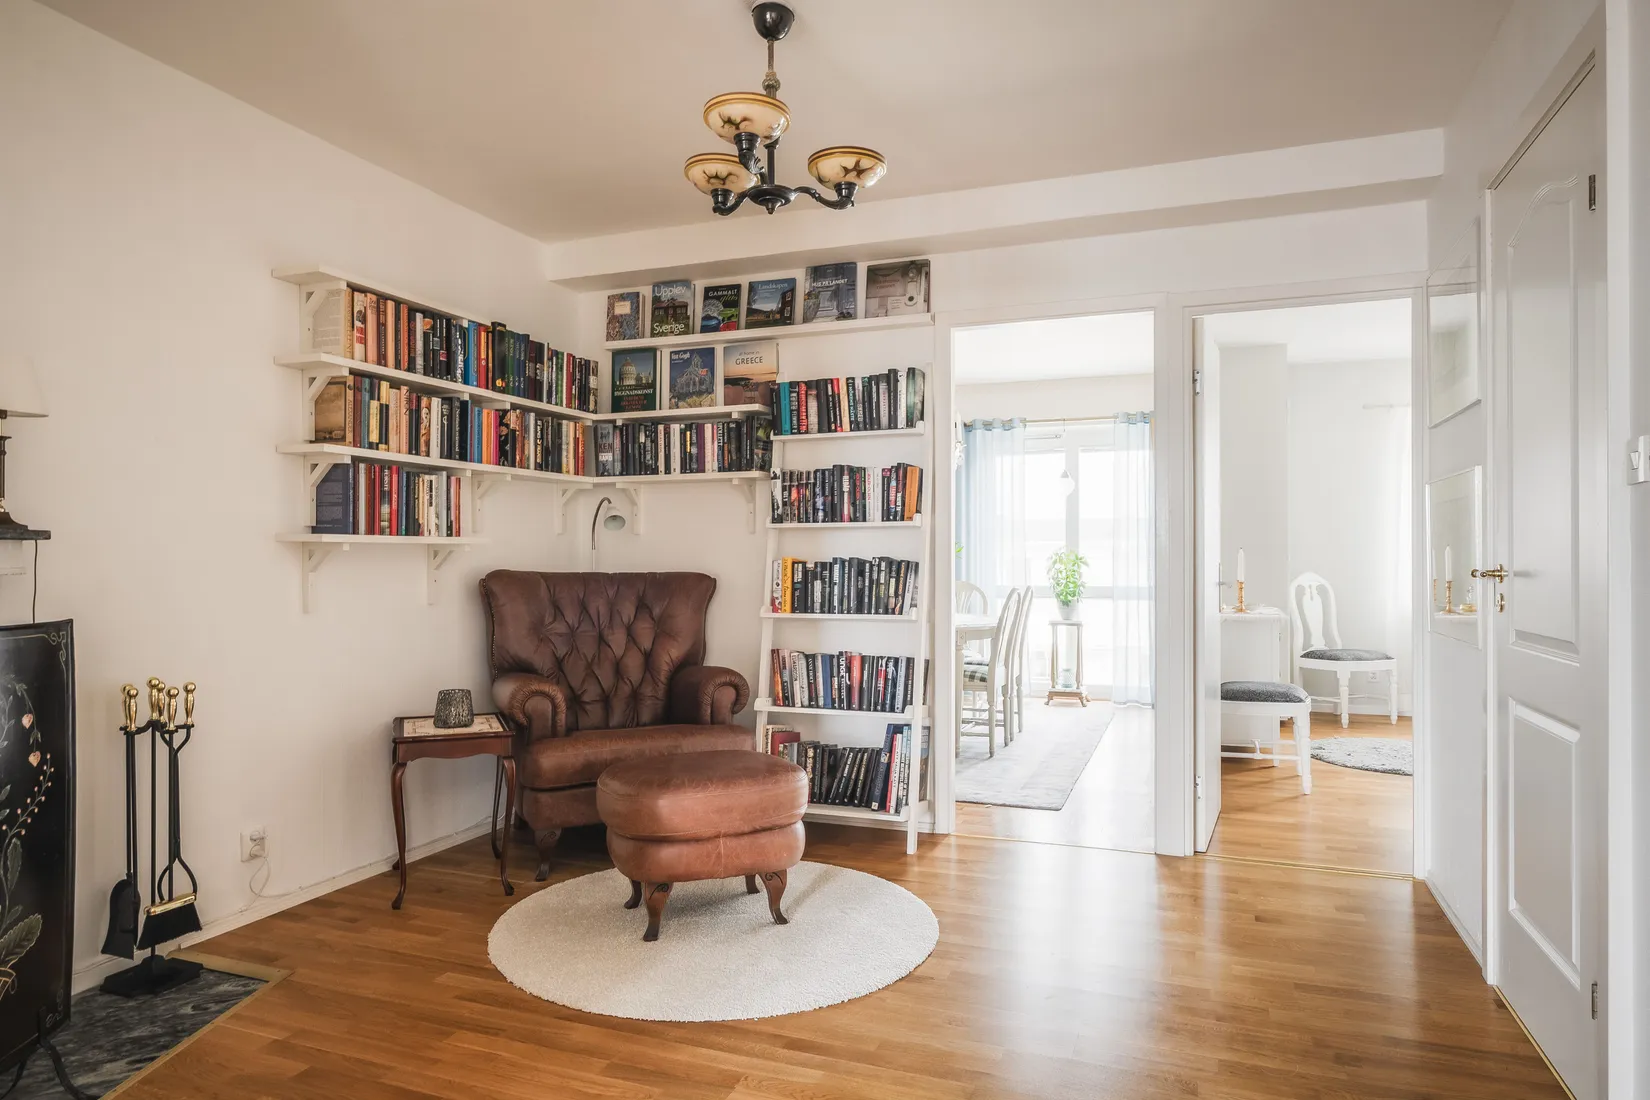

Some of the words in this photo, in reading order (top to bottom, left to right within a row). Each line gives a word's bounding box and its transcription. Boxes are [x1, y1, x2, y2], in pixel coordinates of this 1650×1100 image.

[655, 284, 686, 298] Upplev
[708, 289, 738, 297] GAMMALT
[654, 322, 684, 334] Sverige
[735, 356, 763, 366] GREECE
